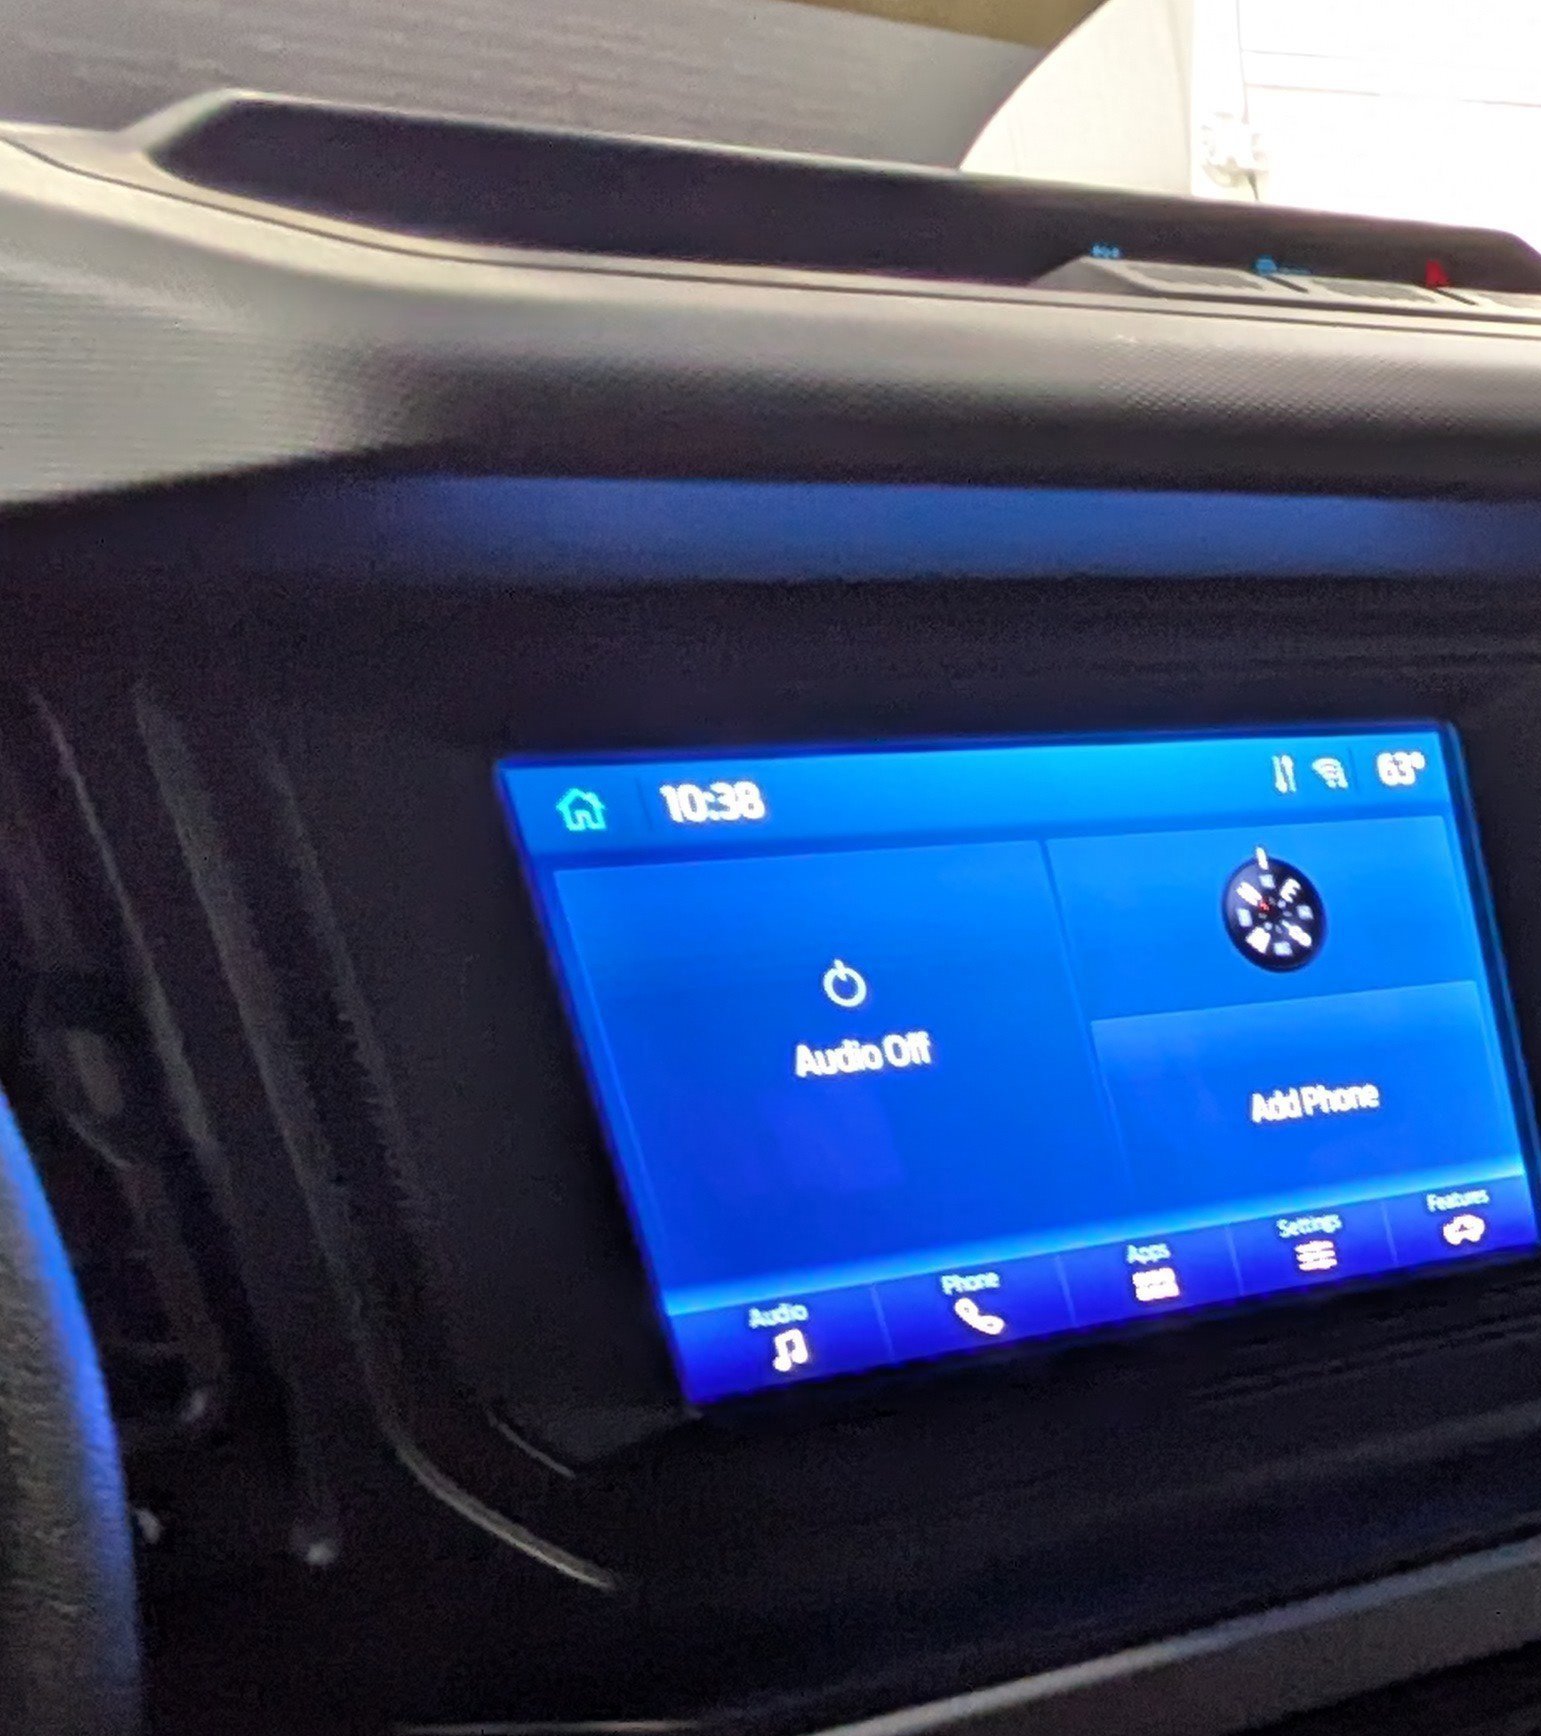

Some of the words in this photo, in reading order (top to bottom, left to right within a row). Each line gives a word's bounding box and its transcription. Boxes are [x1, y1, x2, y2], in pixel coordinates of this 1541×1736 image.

[659, 780, 766, 823] 10:38
[795, 1038, 884, 1078] Audio
[882, 1030, 932, 1068] Off
[1251, 1087, 1303, 1124] Add
[1300, 1083, 1380, 1117] Phone
[1426, 1188, 1491, 1213] Features
[1276, 1214, 1343, 1240] Settings
[1126, 1243, 1172, 1265] Apps
[940, 1272, 1000, 1296] Phone
[748, 1302, 810, 1329] Audio
